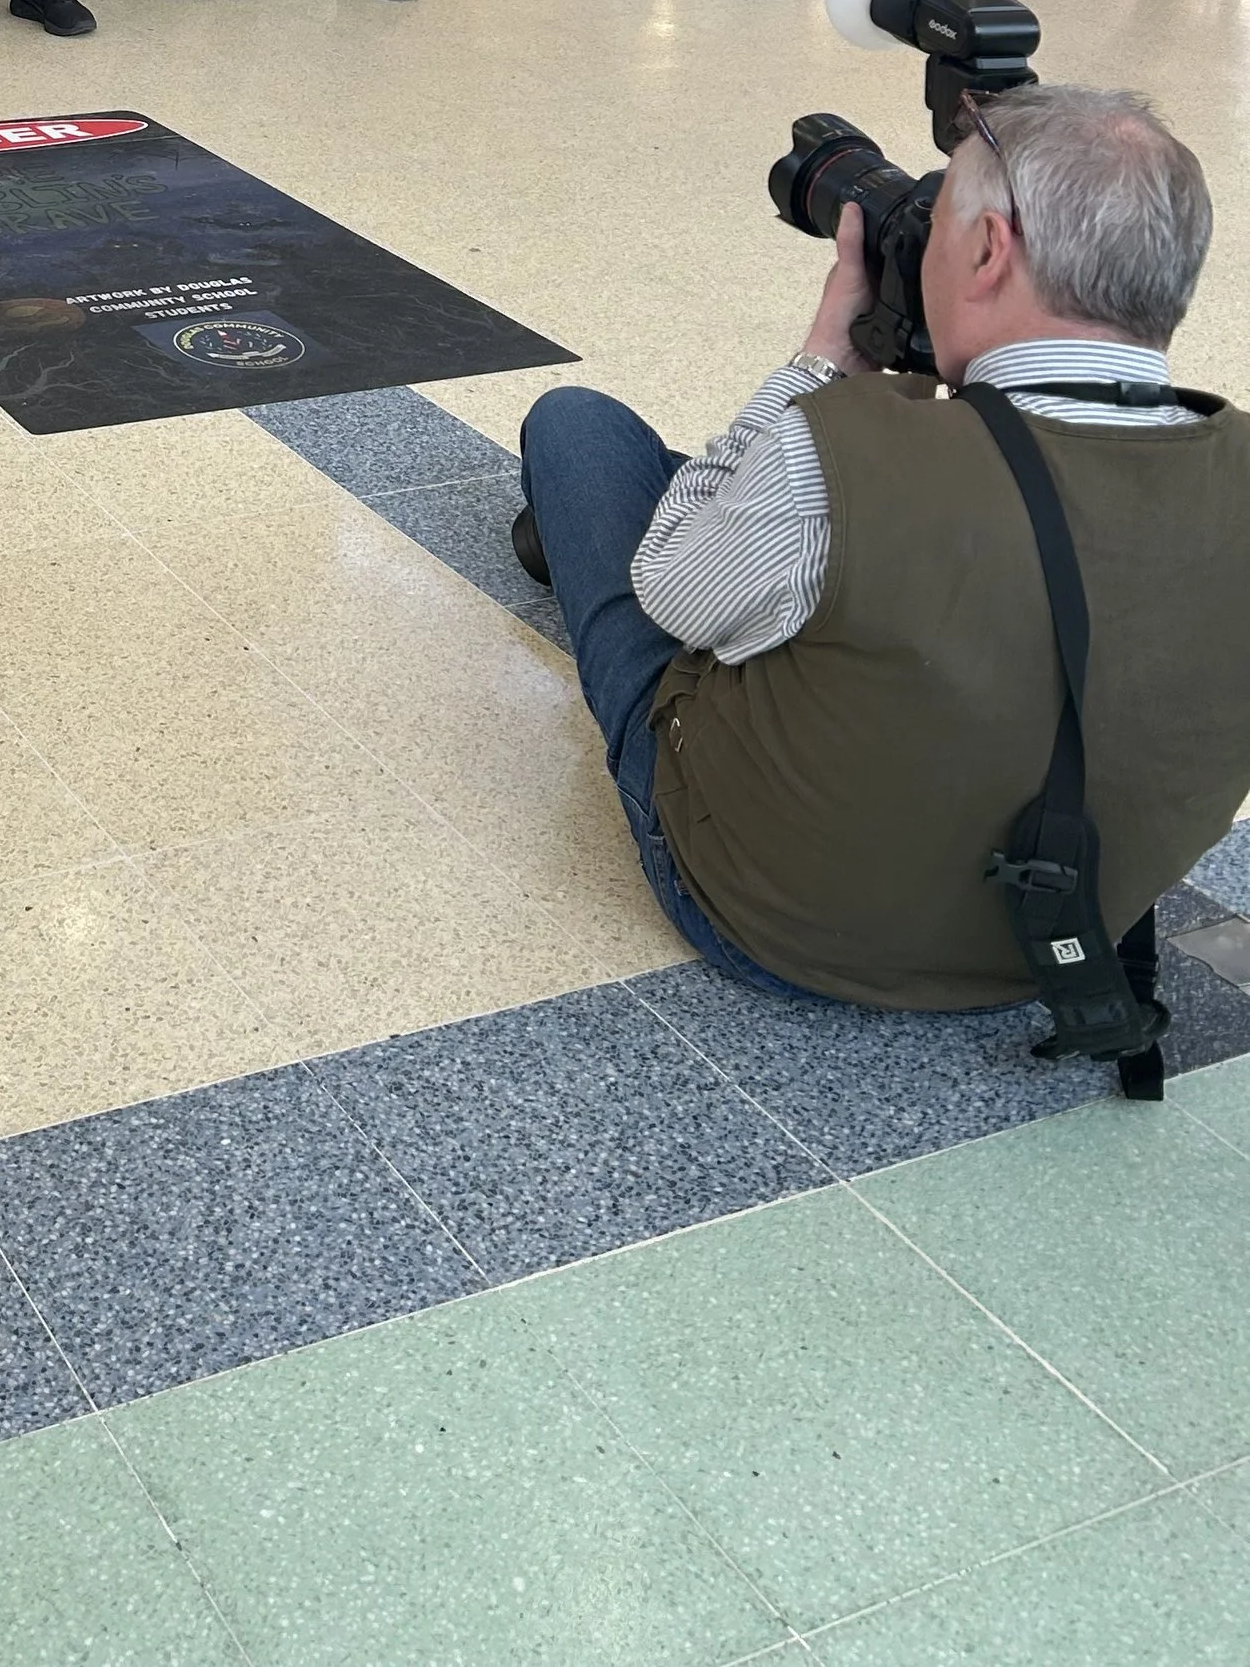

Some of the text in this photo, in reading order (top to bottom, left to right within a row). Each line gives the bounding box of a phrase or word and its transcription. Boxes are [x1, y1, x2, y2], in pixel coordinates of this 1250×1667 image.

[65, 276, 253, 305] ARTWORK BY DOUGLAS
[89, 287, 258, 314] COMMUNITY SCHOOL
[144, 302, 234, 319] STUDENTS
[203, 323, 285, 338] COMMUNITY
